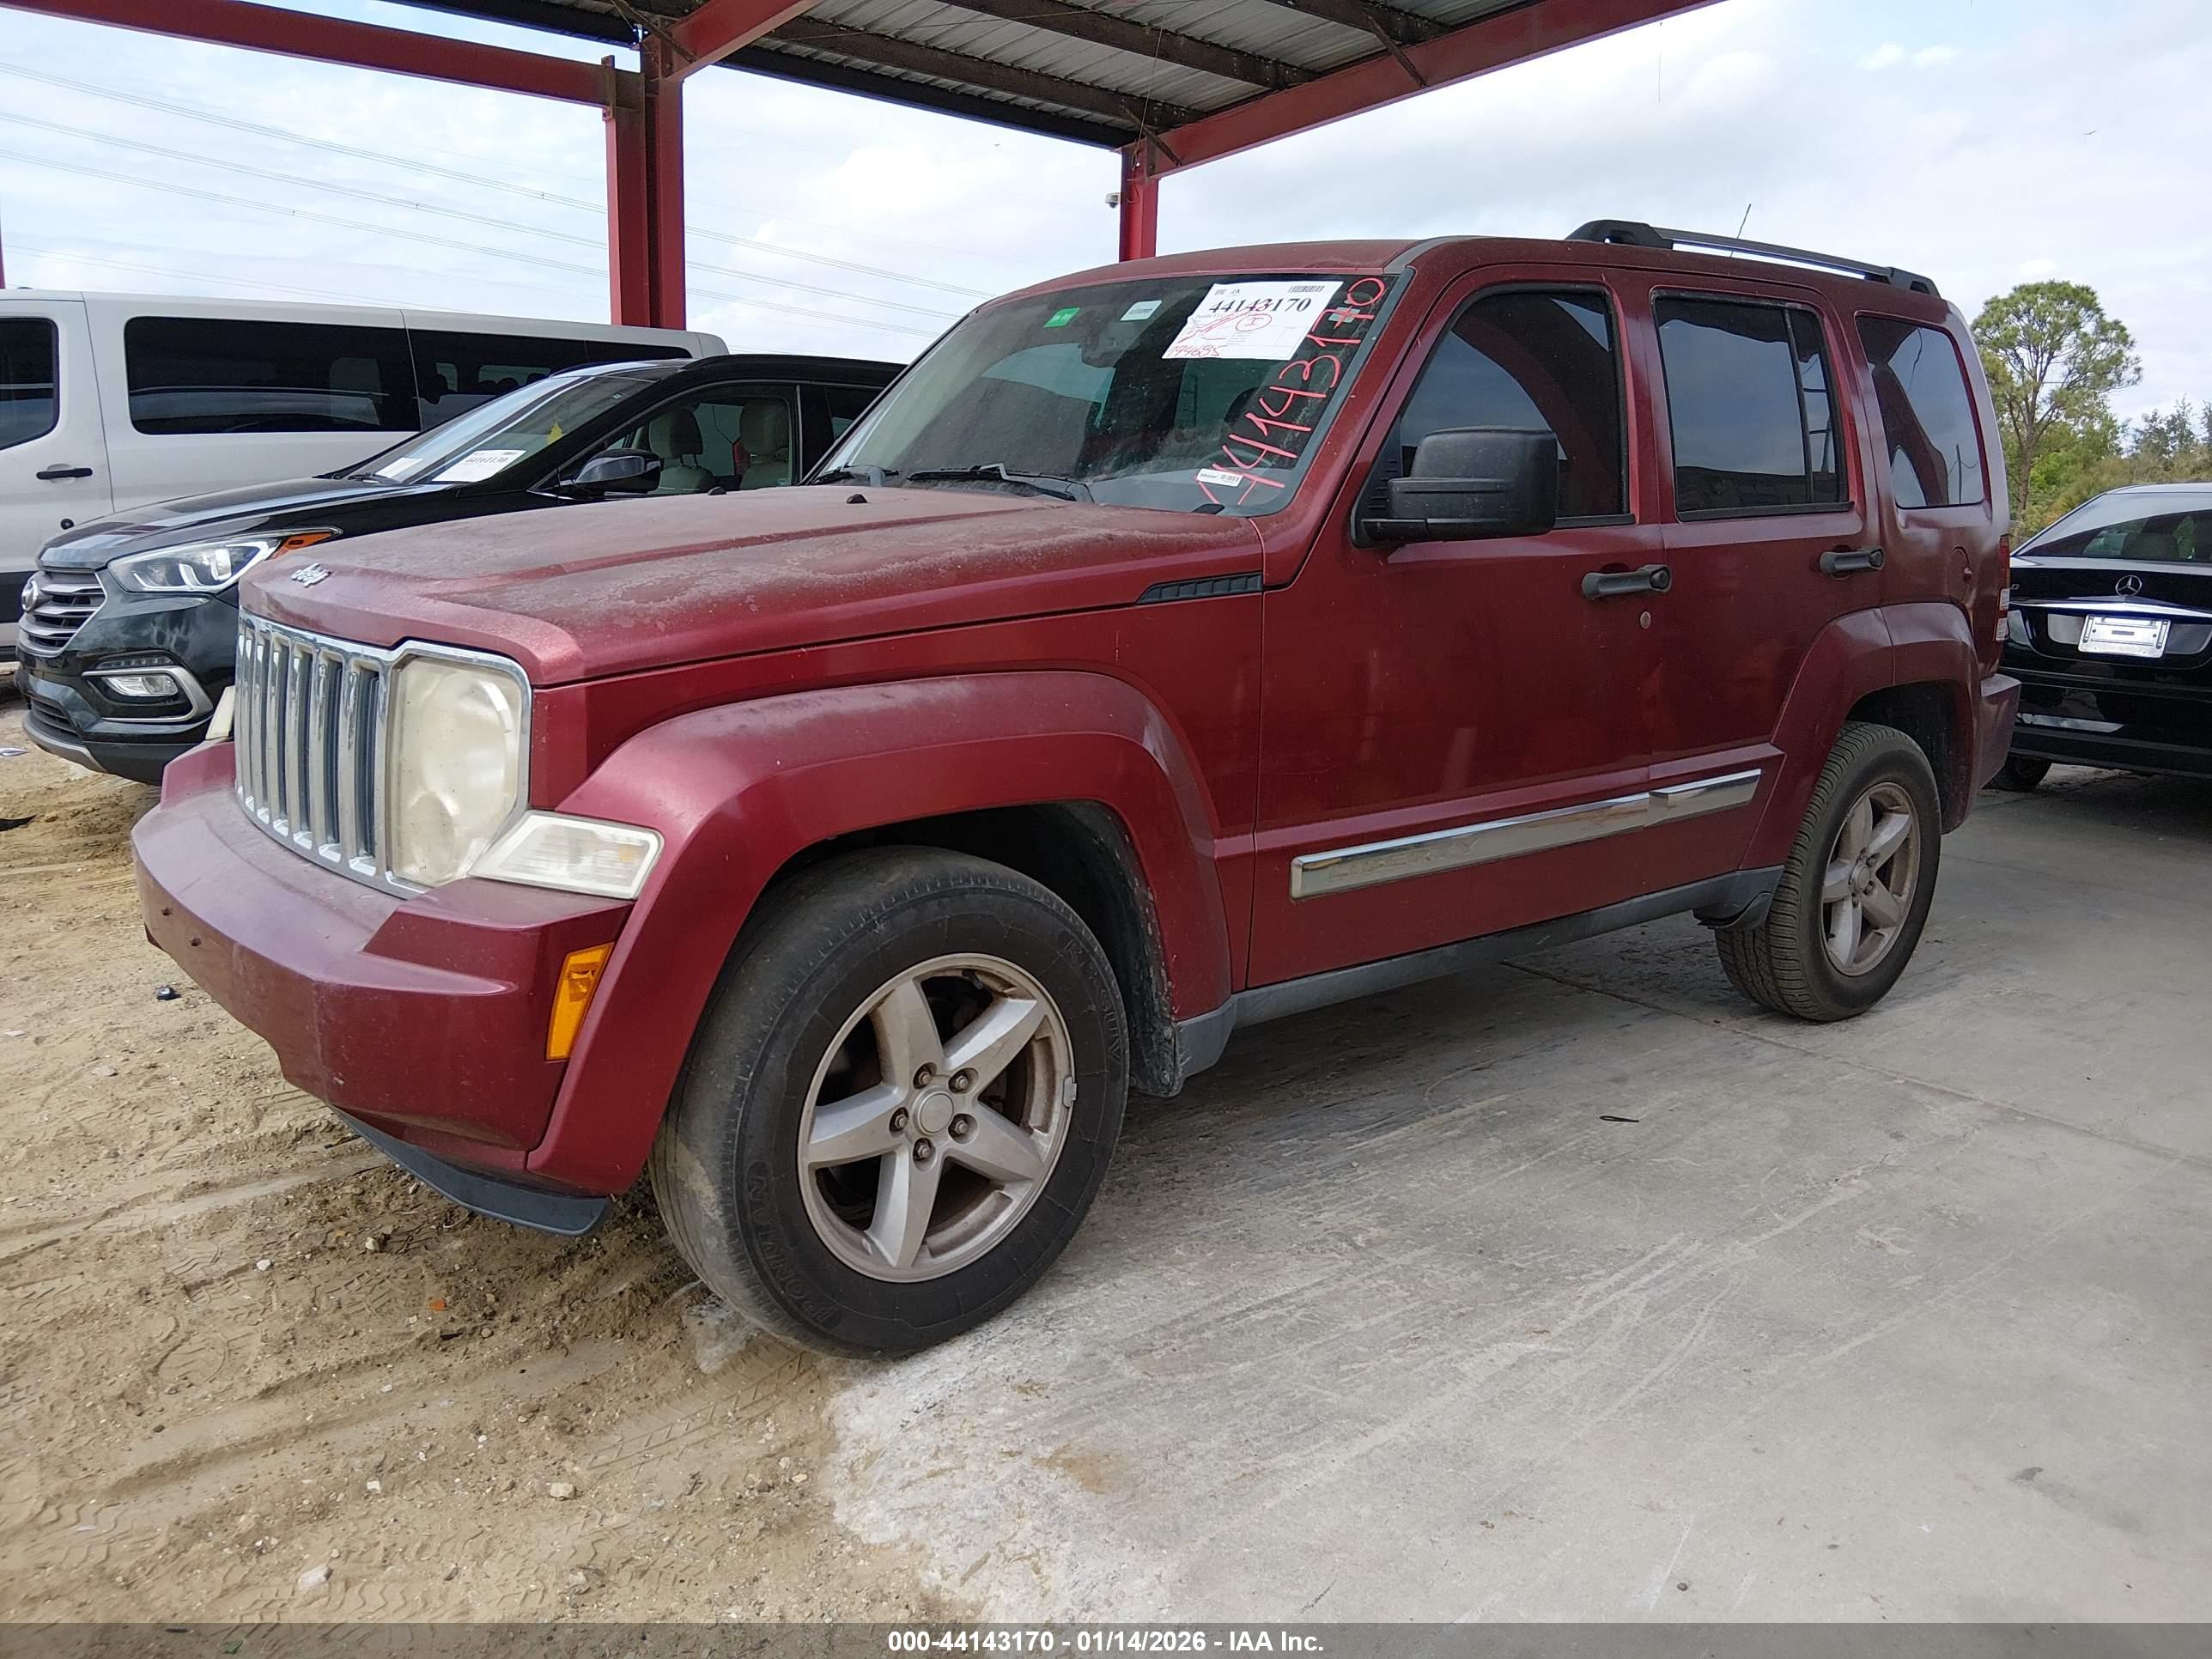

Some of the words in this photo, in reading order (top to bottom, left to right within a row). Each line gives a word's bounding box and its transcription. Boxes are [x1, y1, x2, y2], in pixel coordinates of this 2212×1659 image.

[1209, 297, 1312, 313] 44143170
[1194, 276, 1386, 505] 44143170
[290, 562, 331, 587] Jeep
